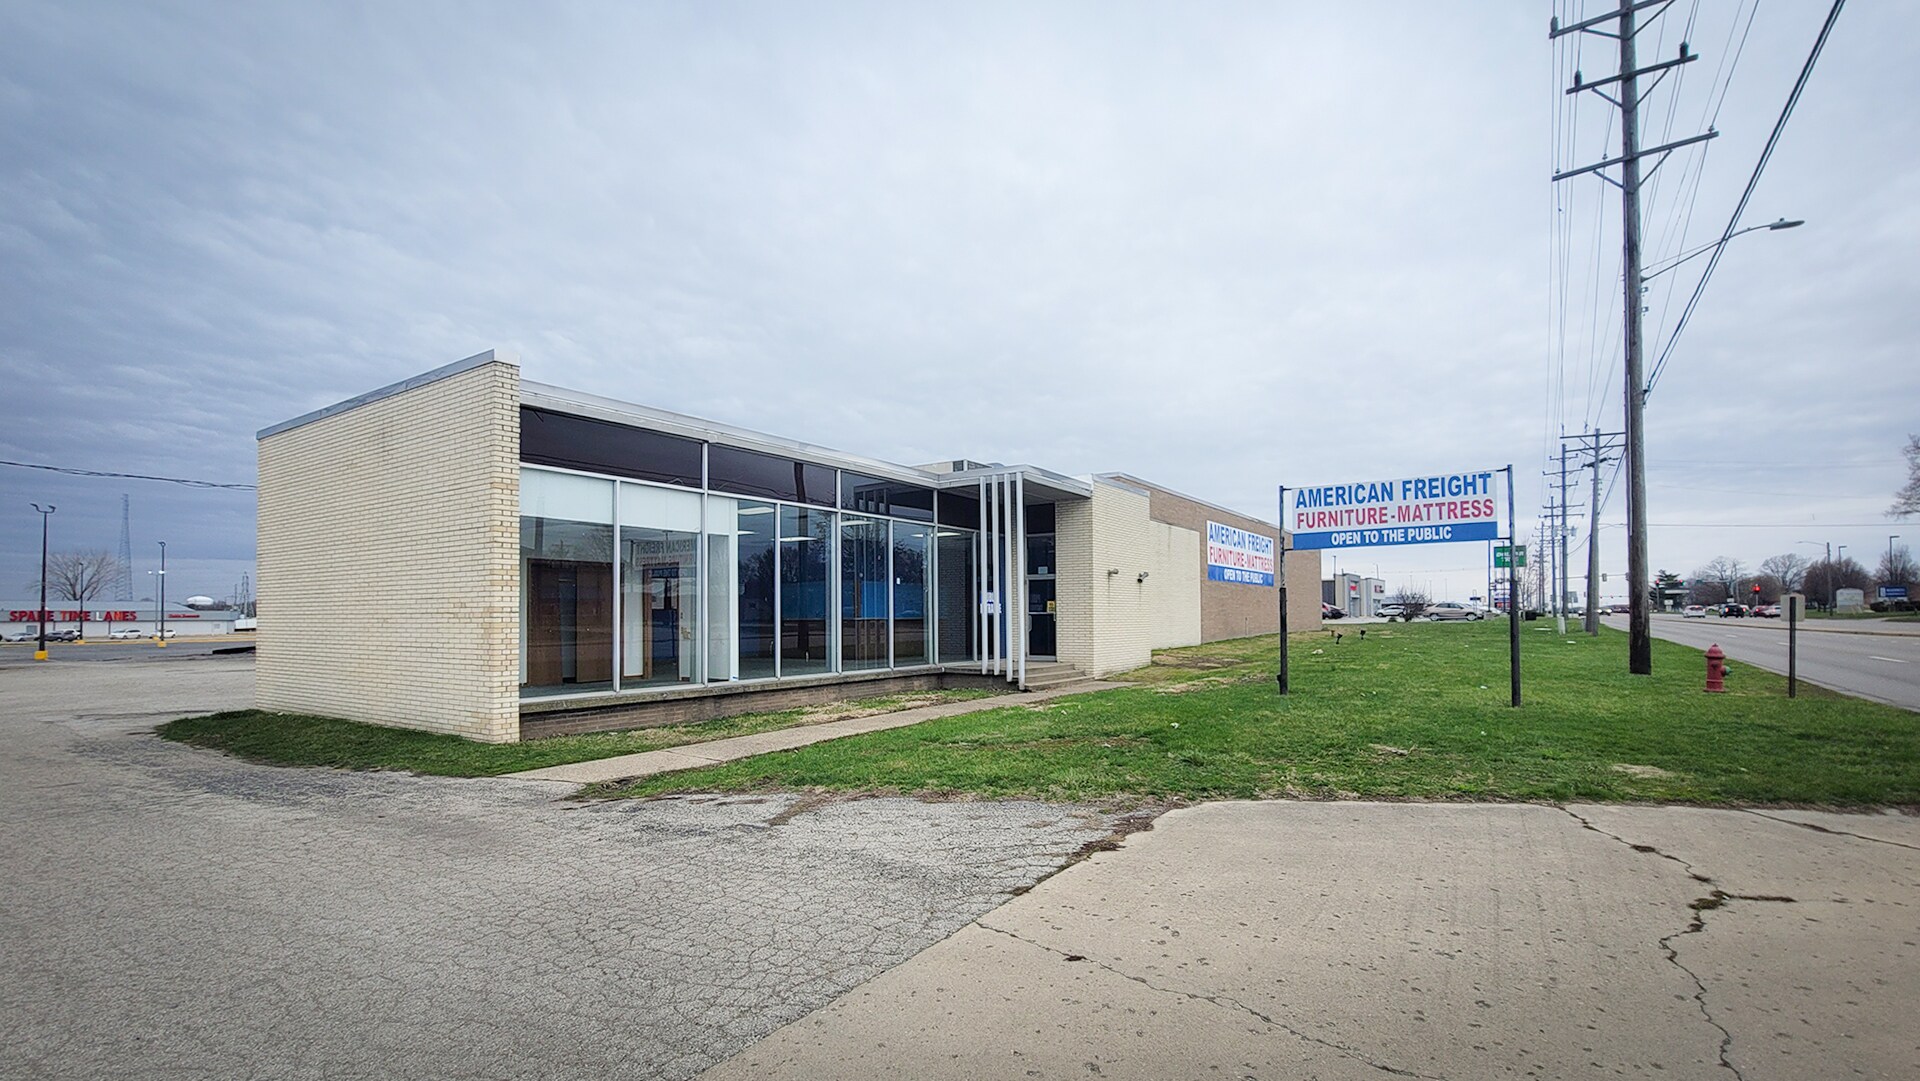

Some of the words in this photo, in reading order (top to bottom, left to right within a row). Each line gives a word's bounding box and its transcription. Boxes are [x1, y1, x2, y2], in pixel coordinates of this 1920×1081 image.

[1296, 482, 1393, 508] AMERICAN
[1402, 472, 1491, 500] FREIGHT
[1209, 523, 1246, 548] AMERICAN
[1248, 533, 1272, 555] FREIGHT
[1331, 532, 1360, 545] OPEN
[1363, 530, 1379, 543] TO
[1382, 528, 1405, 543] THE
[1408, 526, 1452, 541] PUBLIC
[95, 610, 137, 621] LANES
